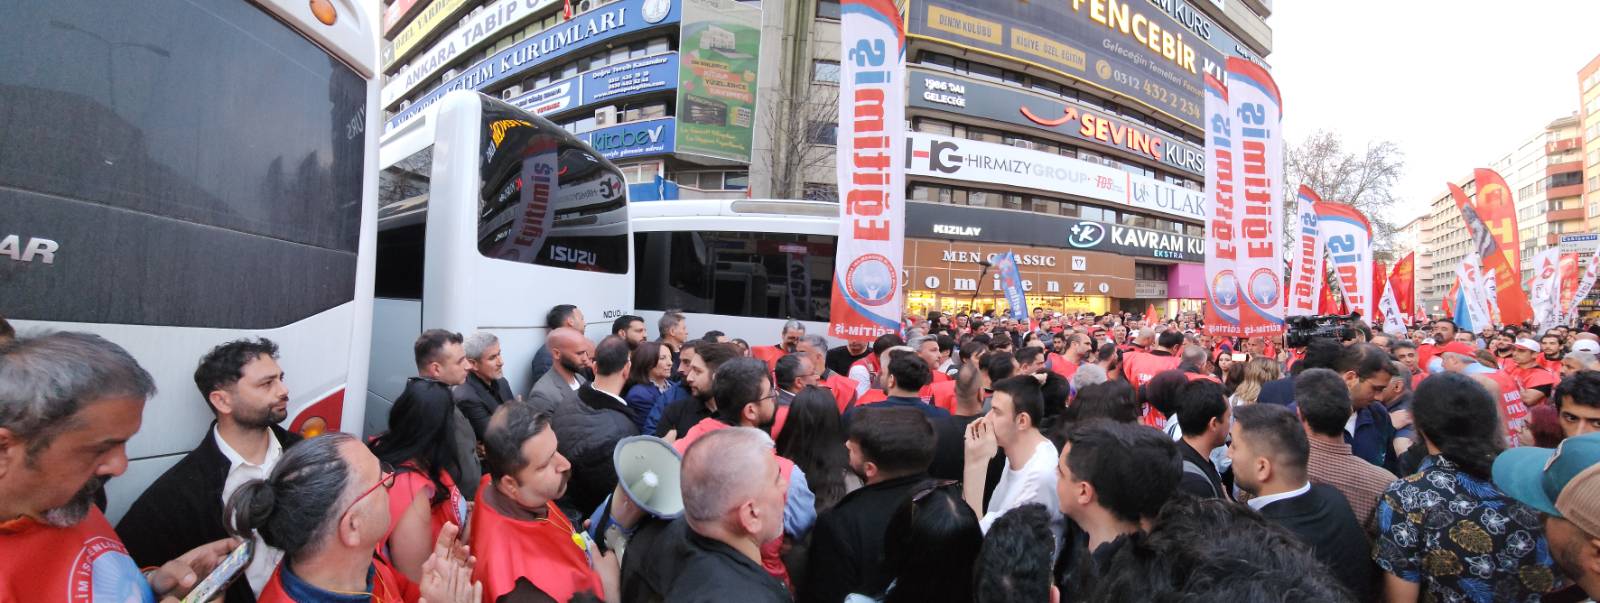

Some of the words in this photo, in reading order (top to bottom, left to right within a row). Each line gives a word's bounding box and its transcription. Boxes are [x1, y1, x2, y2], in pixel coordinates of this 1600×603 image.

[1174, 1, 1211, 40] KURS
[405, 41, 457, 89] ANKARA
[462, 1, 518, 47] TABİP
[500, 7, 626, 74] KURUMLARI
[1102, 38, 1148, 67] Geleceğin
[924, 91, 967, 107] GELECEĞE
[1113, 70, 1140, 91] 0312
[1143, 79, 1167, 102] 432
[1080, 113, 1162, 161] SEVİNÇ
[968, 156, 1031, 175] HIRMIZY
[1033, 163, 1089, 185] GROUP
[1154, 184, 1206, 216] ULAK
[933, 223, 982, 237] KIZILAY
[1111, 227, 1183, 253] KAVRAM
[550, 245, 597, 265] ISUZU
[942, 250, 981, 264] MEN
[986, 253, 1056, 267] CASSIC
[1153, 249, 1184, 259] EKSTRA
